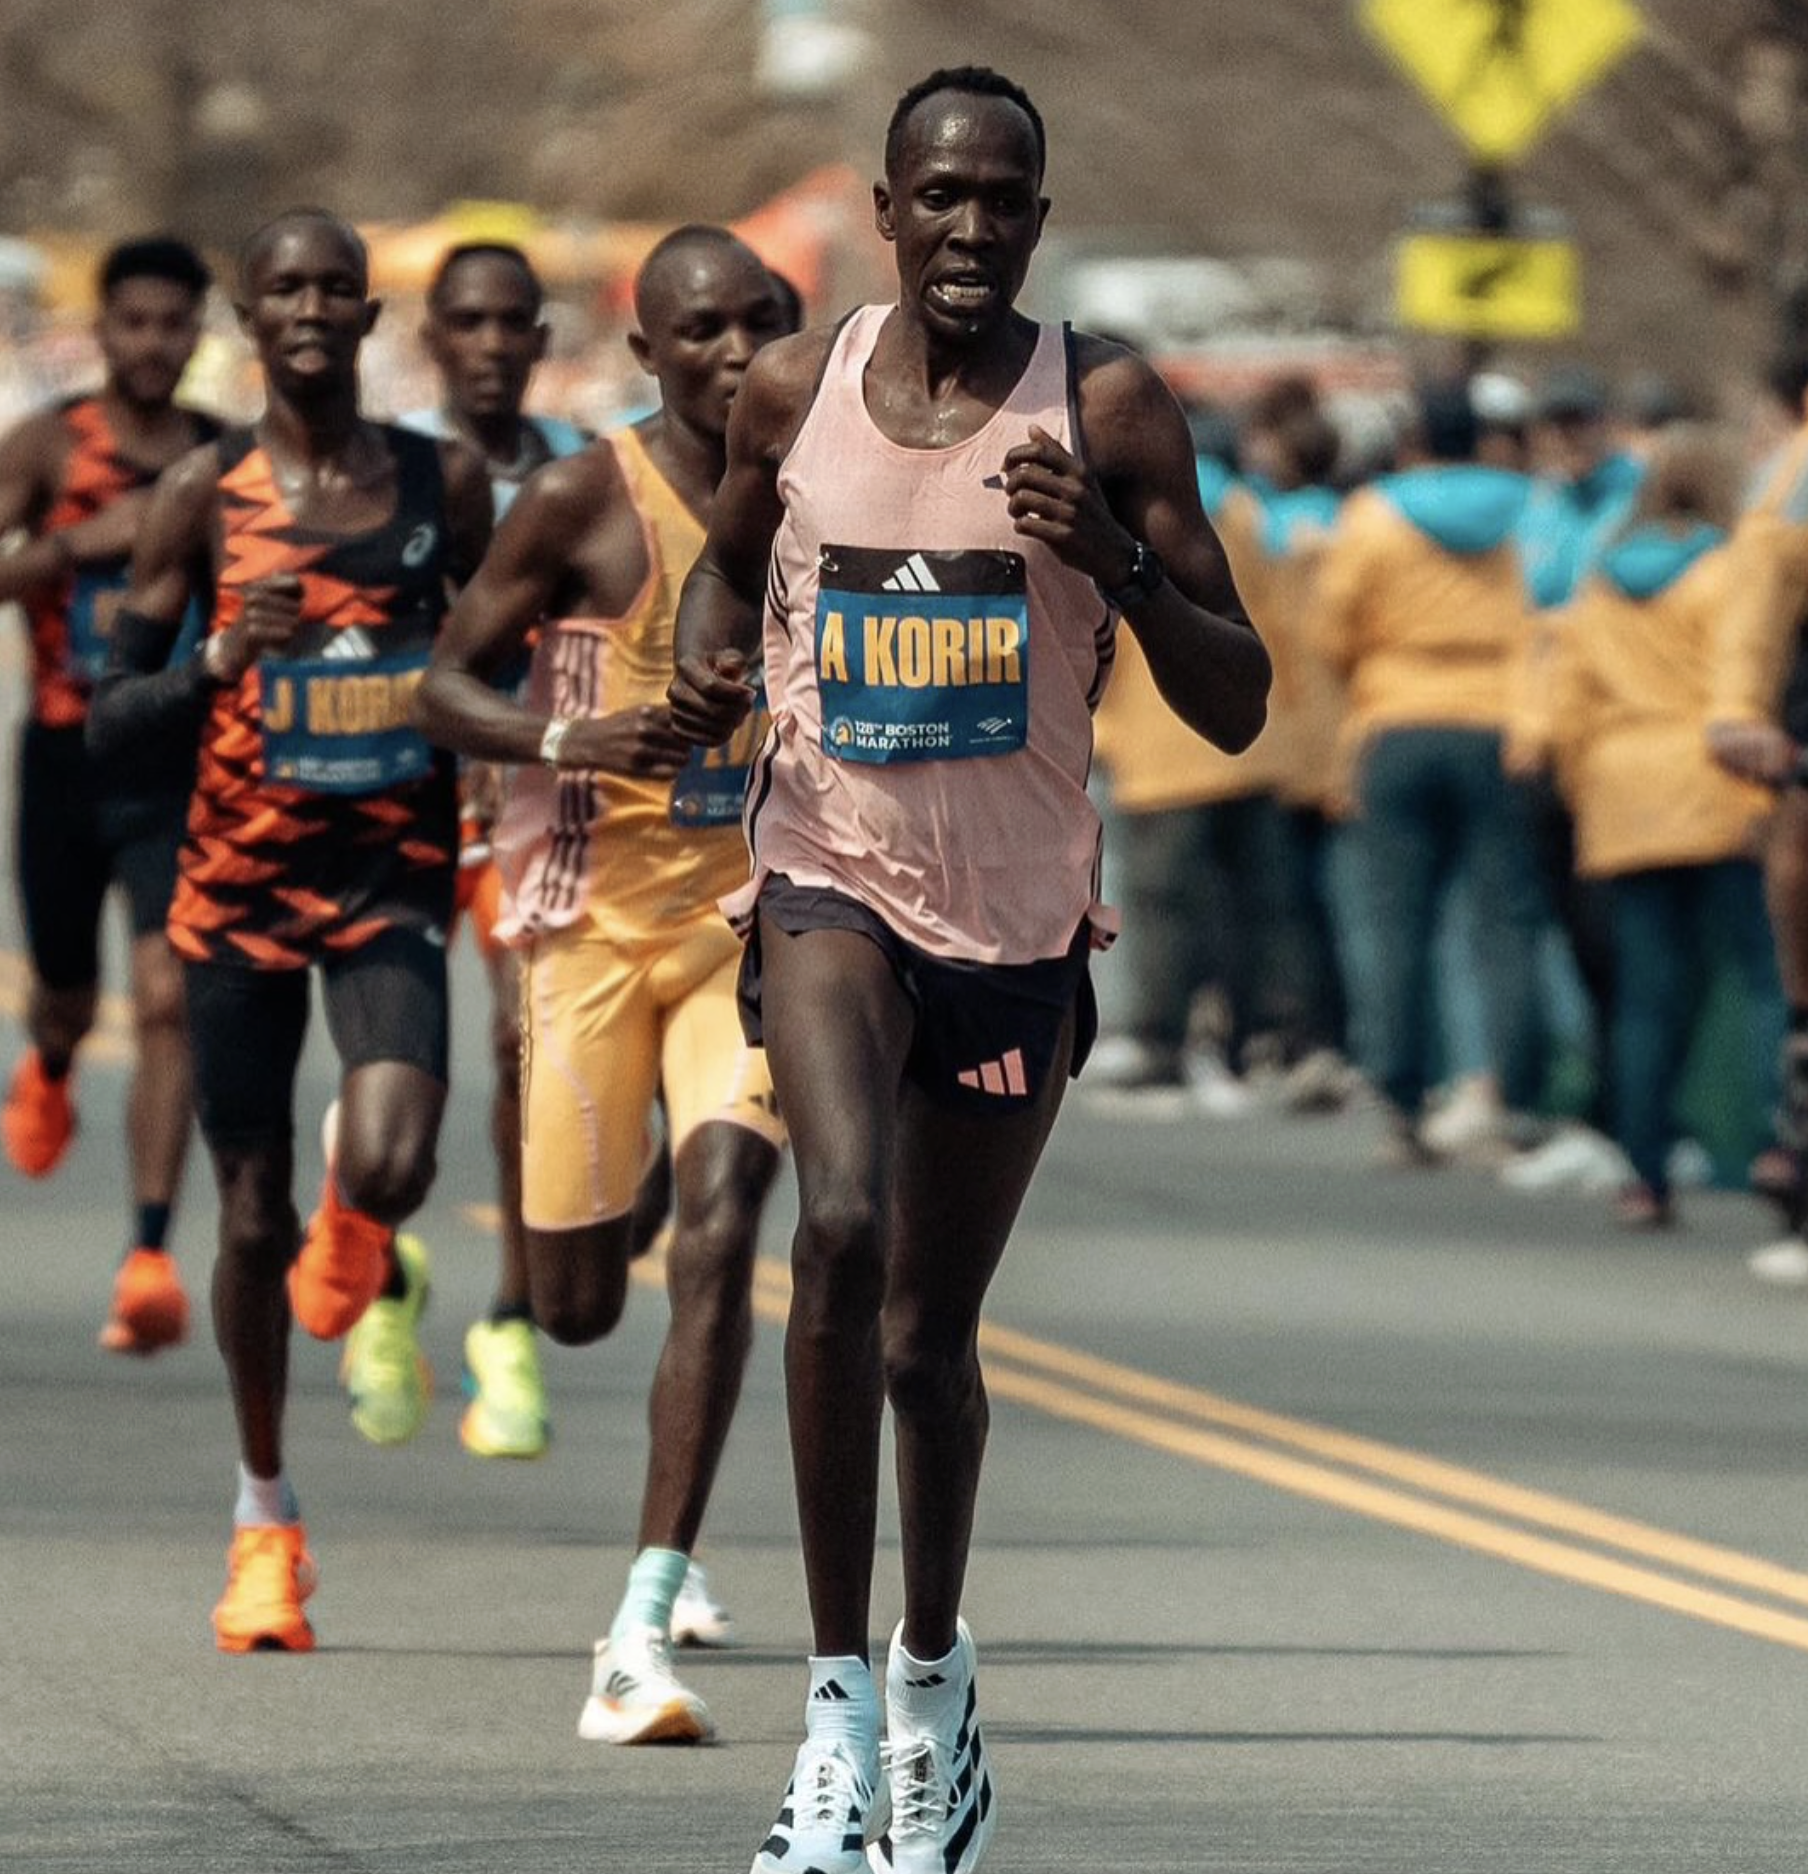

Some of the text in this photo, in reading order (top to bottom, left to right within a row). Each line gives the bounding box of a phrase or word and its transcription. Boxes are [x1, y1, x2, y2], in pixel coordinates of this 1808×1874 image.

[820, 611, 1021, 688] A KORIR
[264, 678, 293, 732] J
[856, 735, 950, 750] MARATHON
[885, 721, 949, 737] BOSTON
